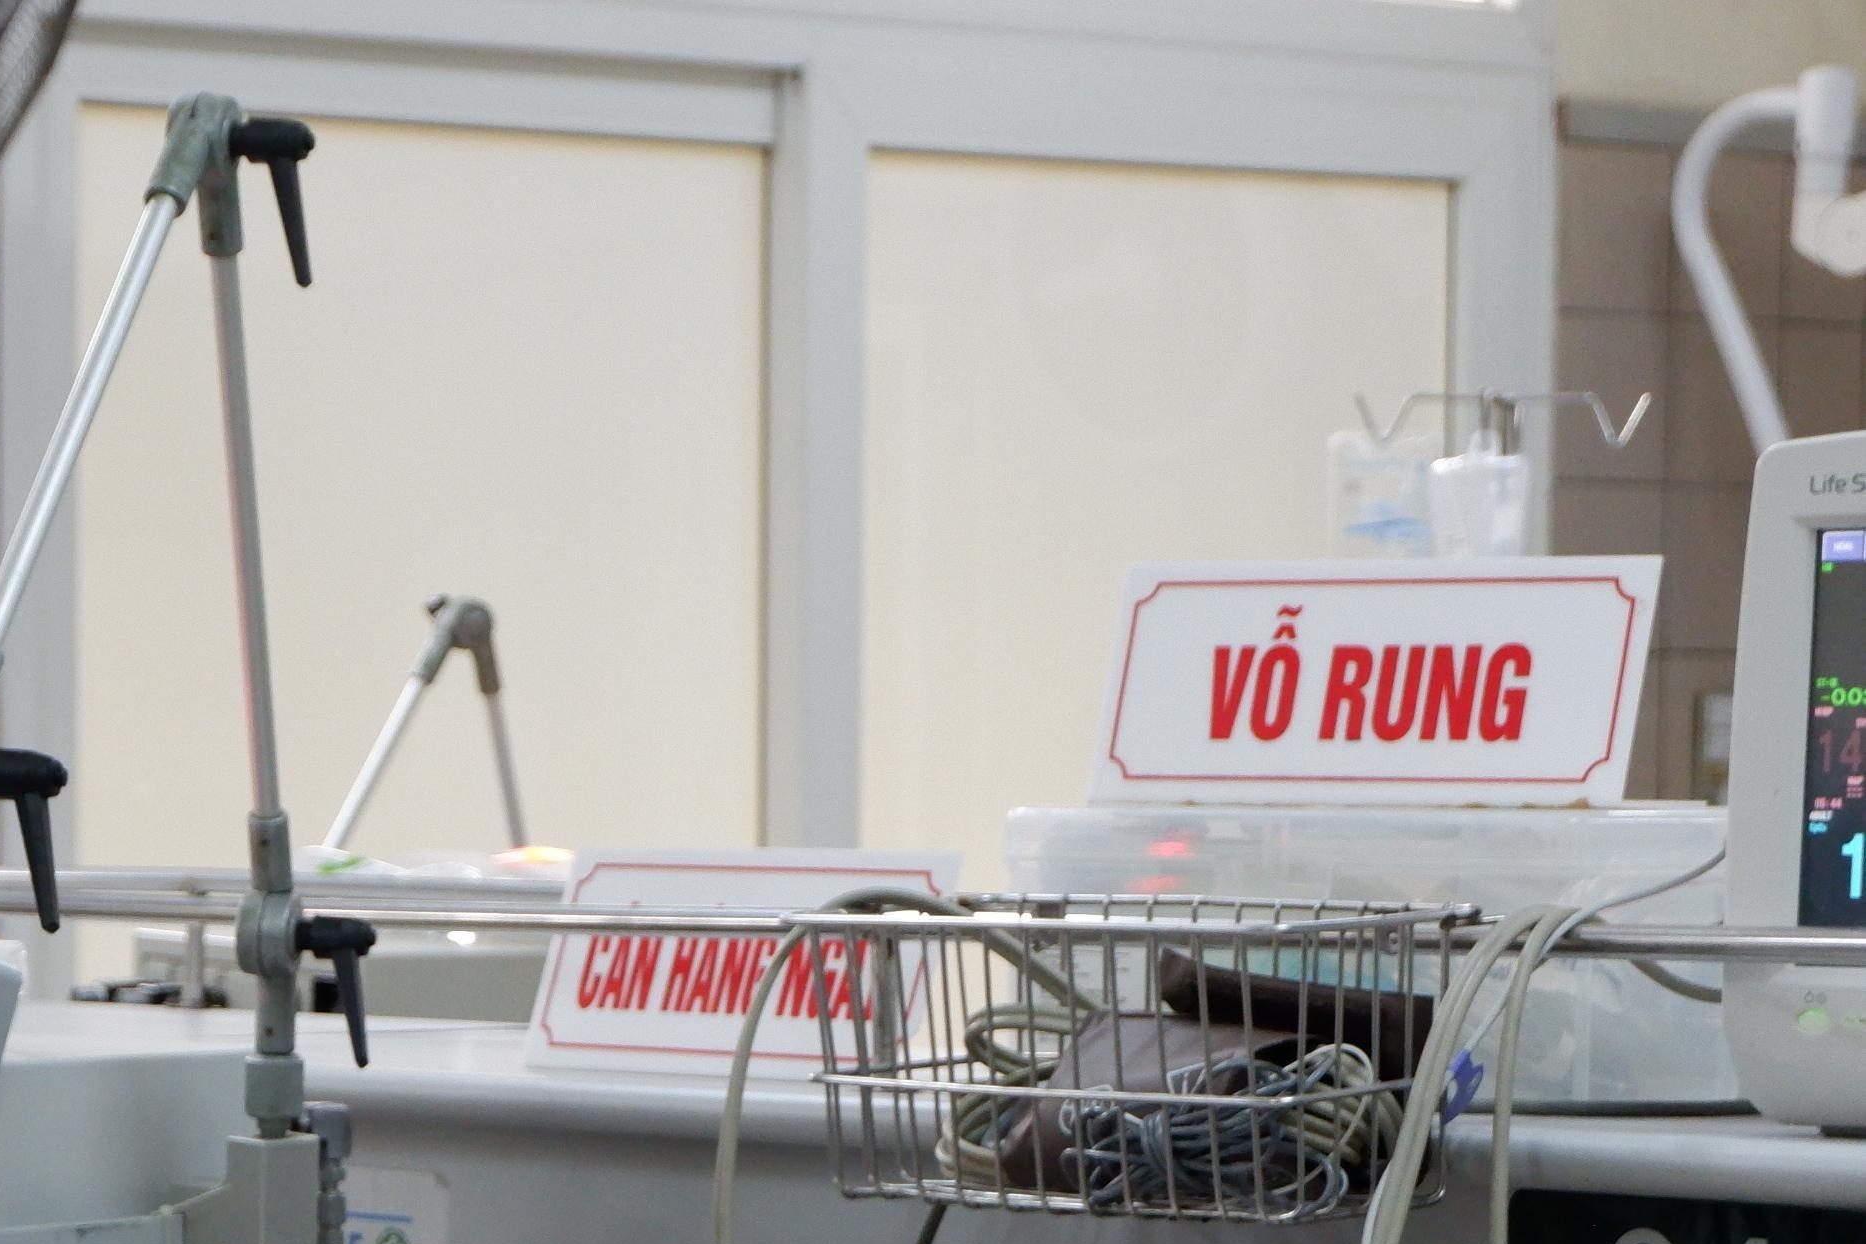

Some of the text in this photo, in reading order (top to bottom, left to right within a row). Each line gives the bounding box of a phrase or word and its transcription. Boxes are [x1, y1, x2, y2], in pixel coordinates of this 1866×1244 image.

[1810, 472, 1847, 495] Life
[1209, 604, 1532, 742] VỖ RUNG
